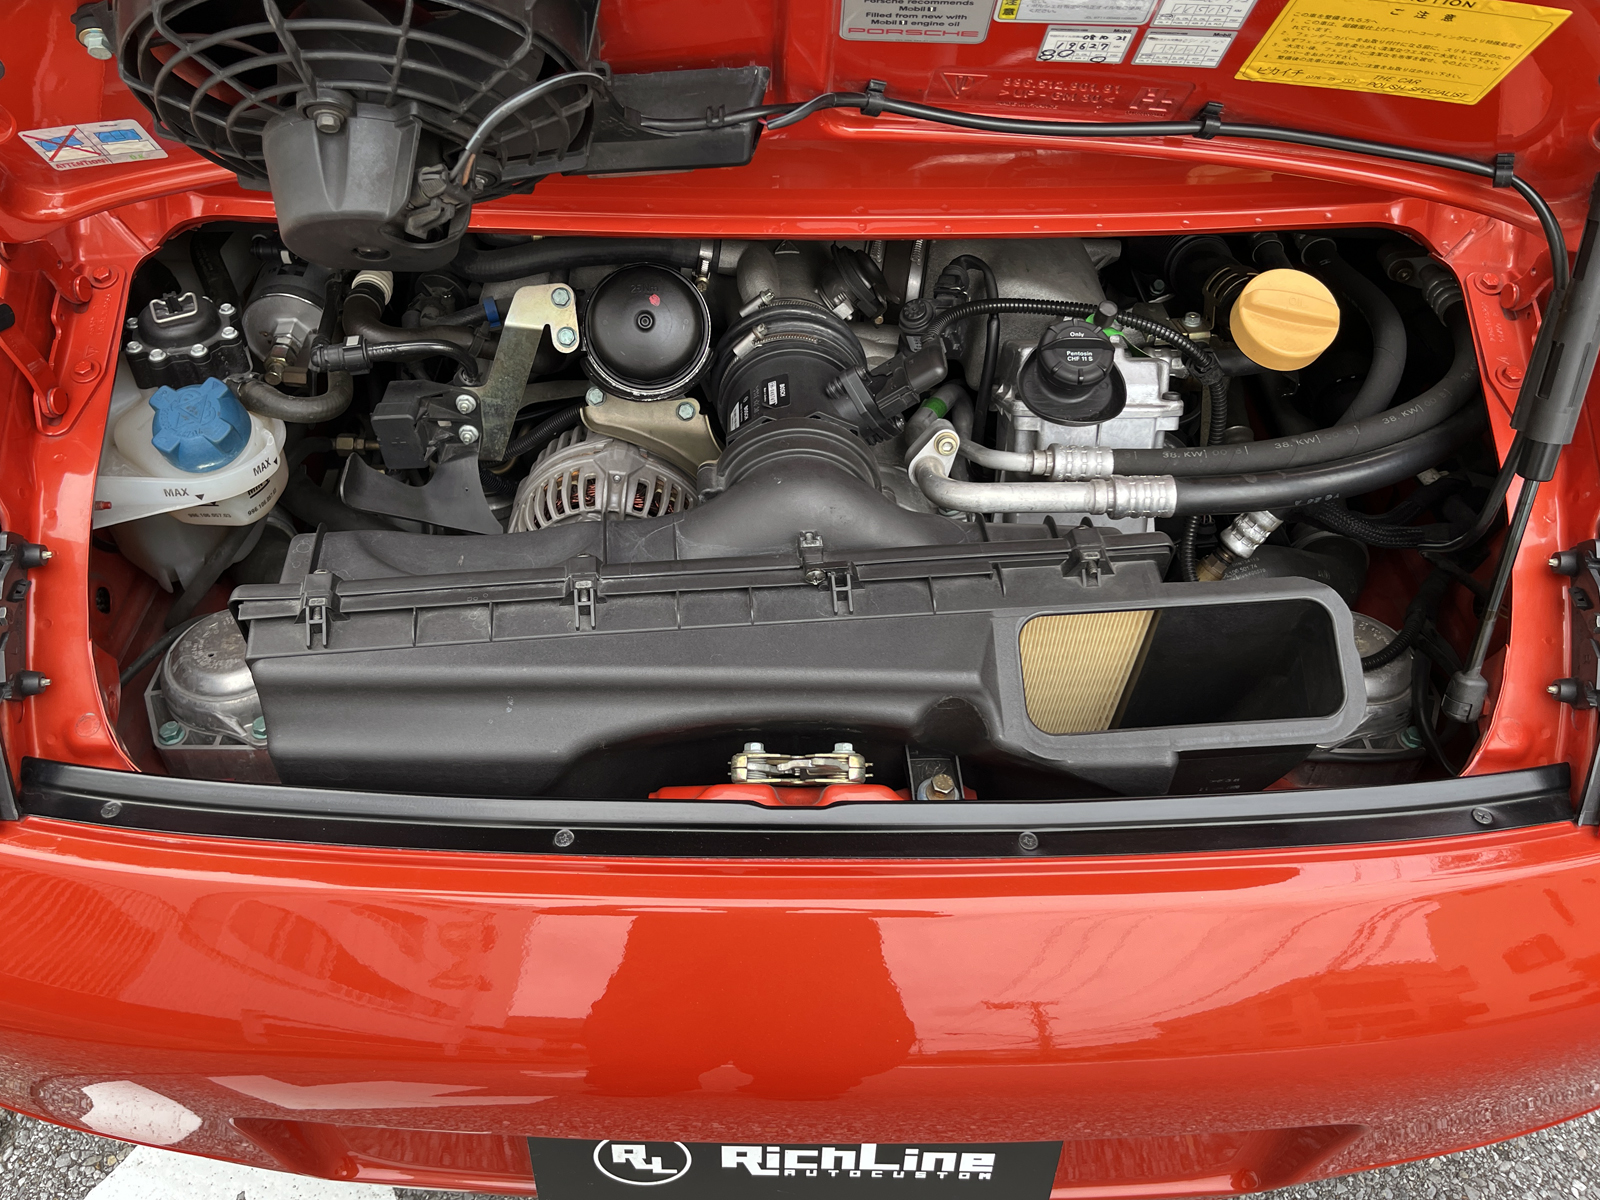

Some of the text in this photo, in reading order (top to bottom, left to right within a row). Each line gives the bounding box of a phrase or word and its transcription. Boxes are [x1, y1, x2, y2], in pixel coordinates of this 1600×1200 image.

[848, 28, 979, 37] PORSCHE
[1408, 86, 1469, 98] SPECIALIST
[252, 457, 272, 476] MAX
[163, 488, 189, 497] MAX
[721, 1143, 996, 1175] RichLine
[784, 1169, 992, 1180] AUTOCUSTOM
